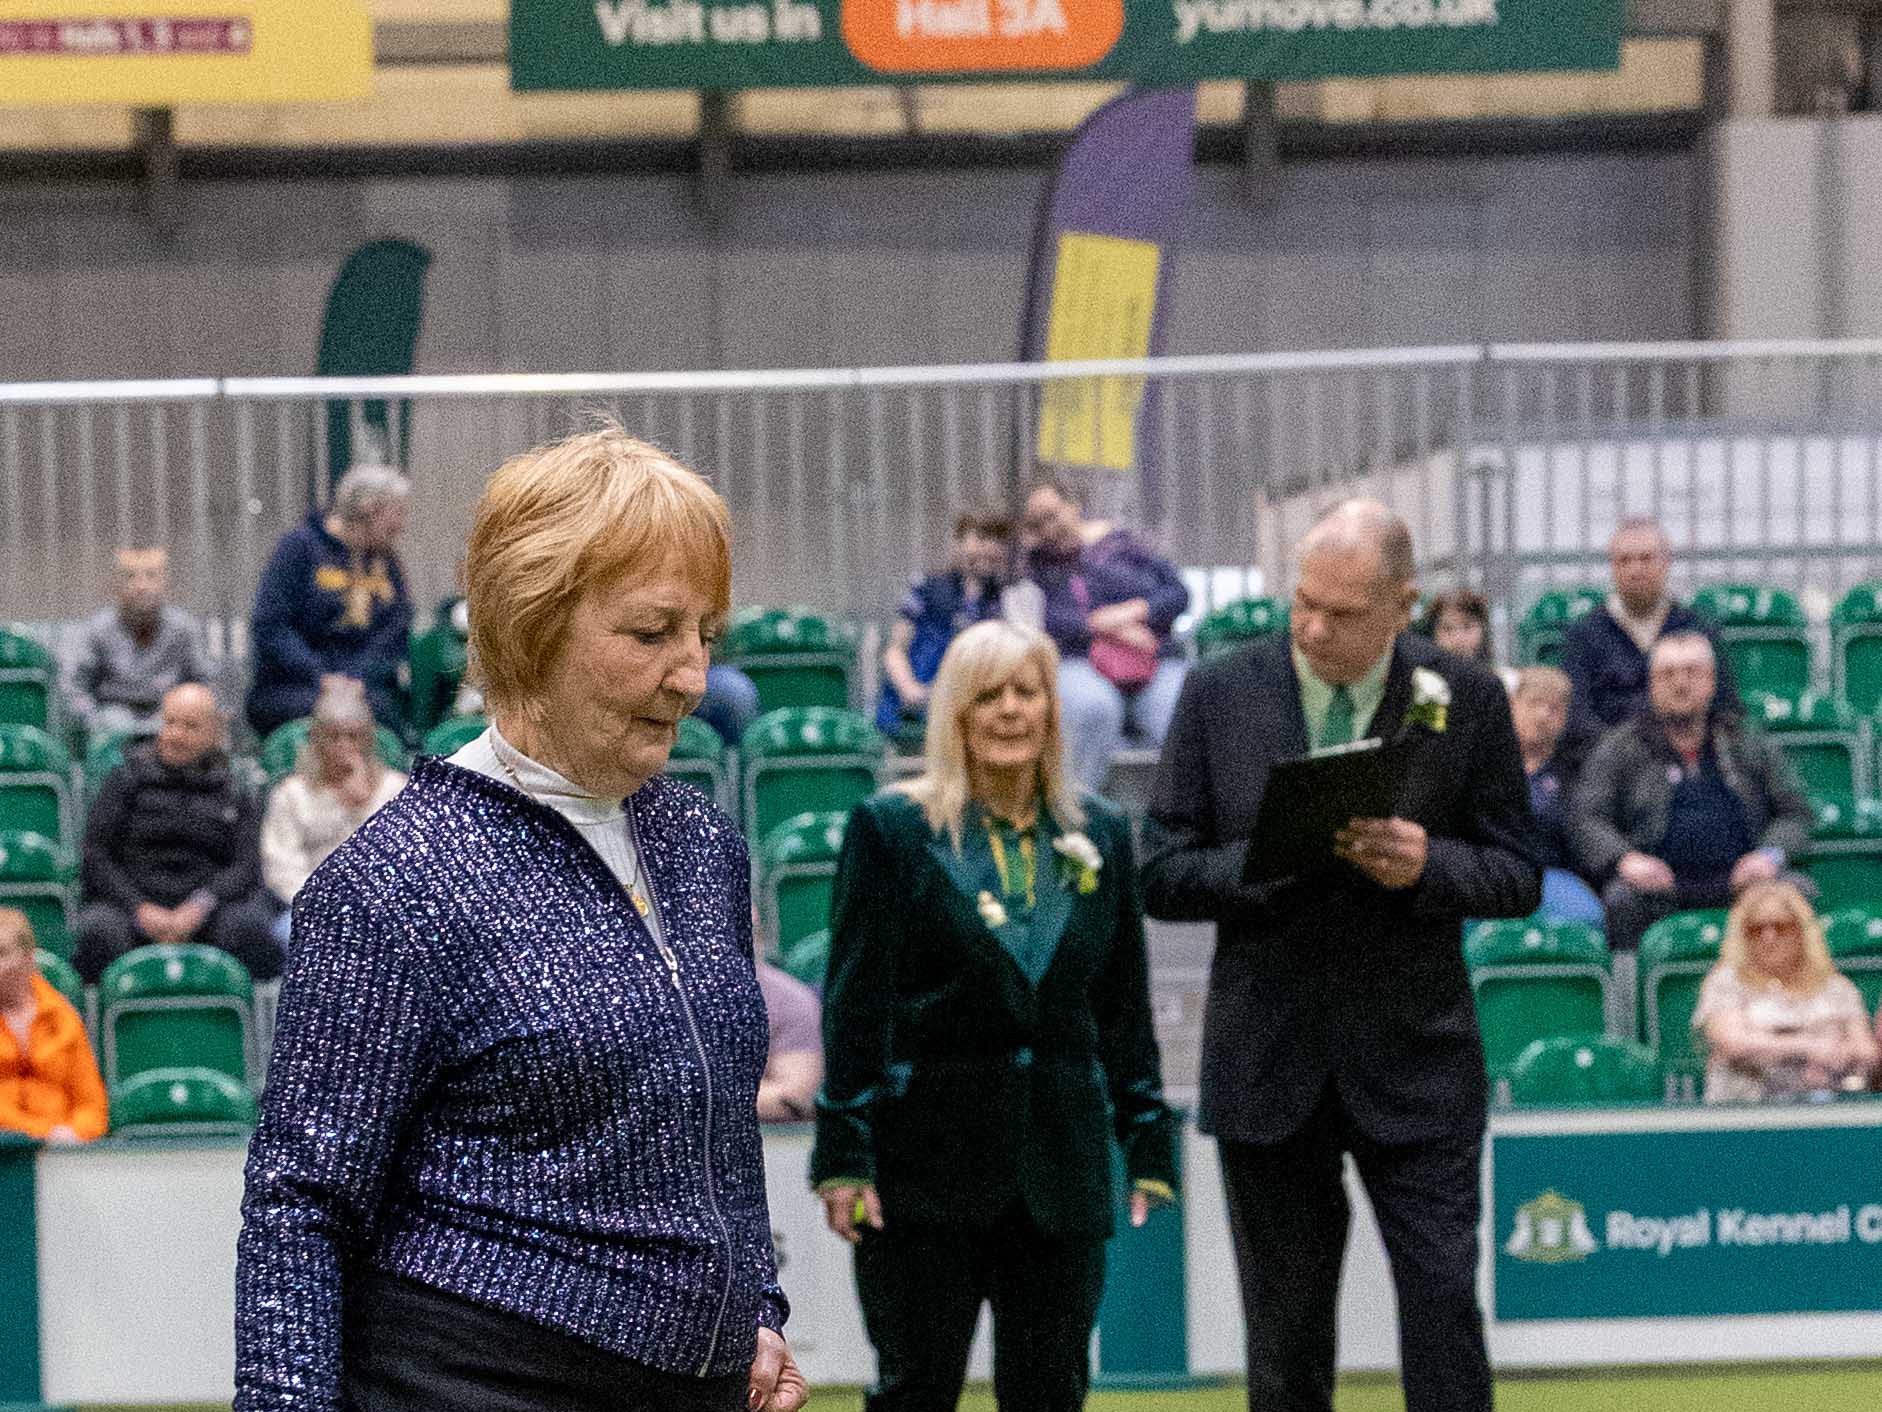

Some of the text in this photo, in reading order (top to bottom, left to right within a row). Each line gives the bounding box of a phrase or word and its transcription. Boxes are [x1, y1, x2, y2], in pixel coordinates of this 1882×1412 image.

[595, 0, 703, 44] Visit
[709, 5, 769, 43] us
[774, 0, 822, 42] in
[1606, 1209, 1710, 1255] Royal
[1717, 1205, 1850, 1245] Kennel
